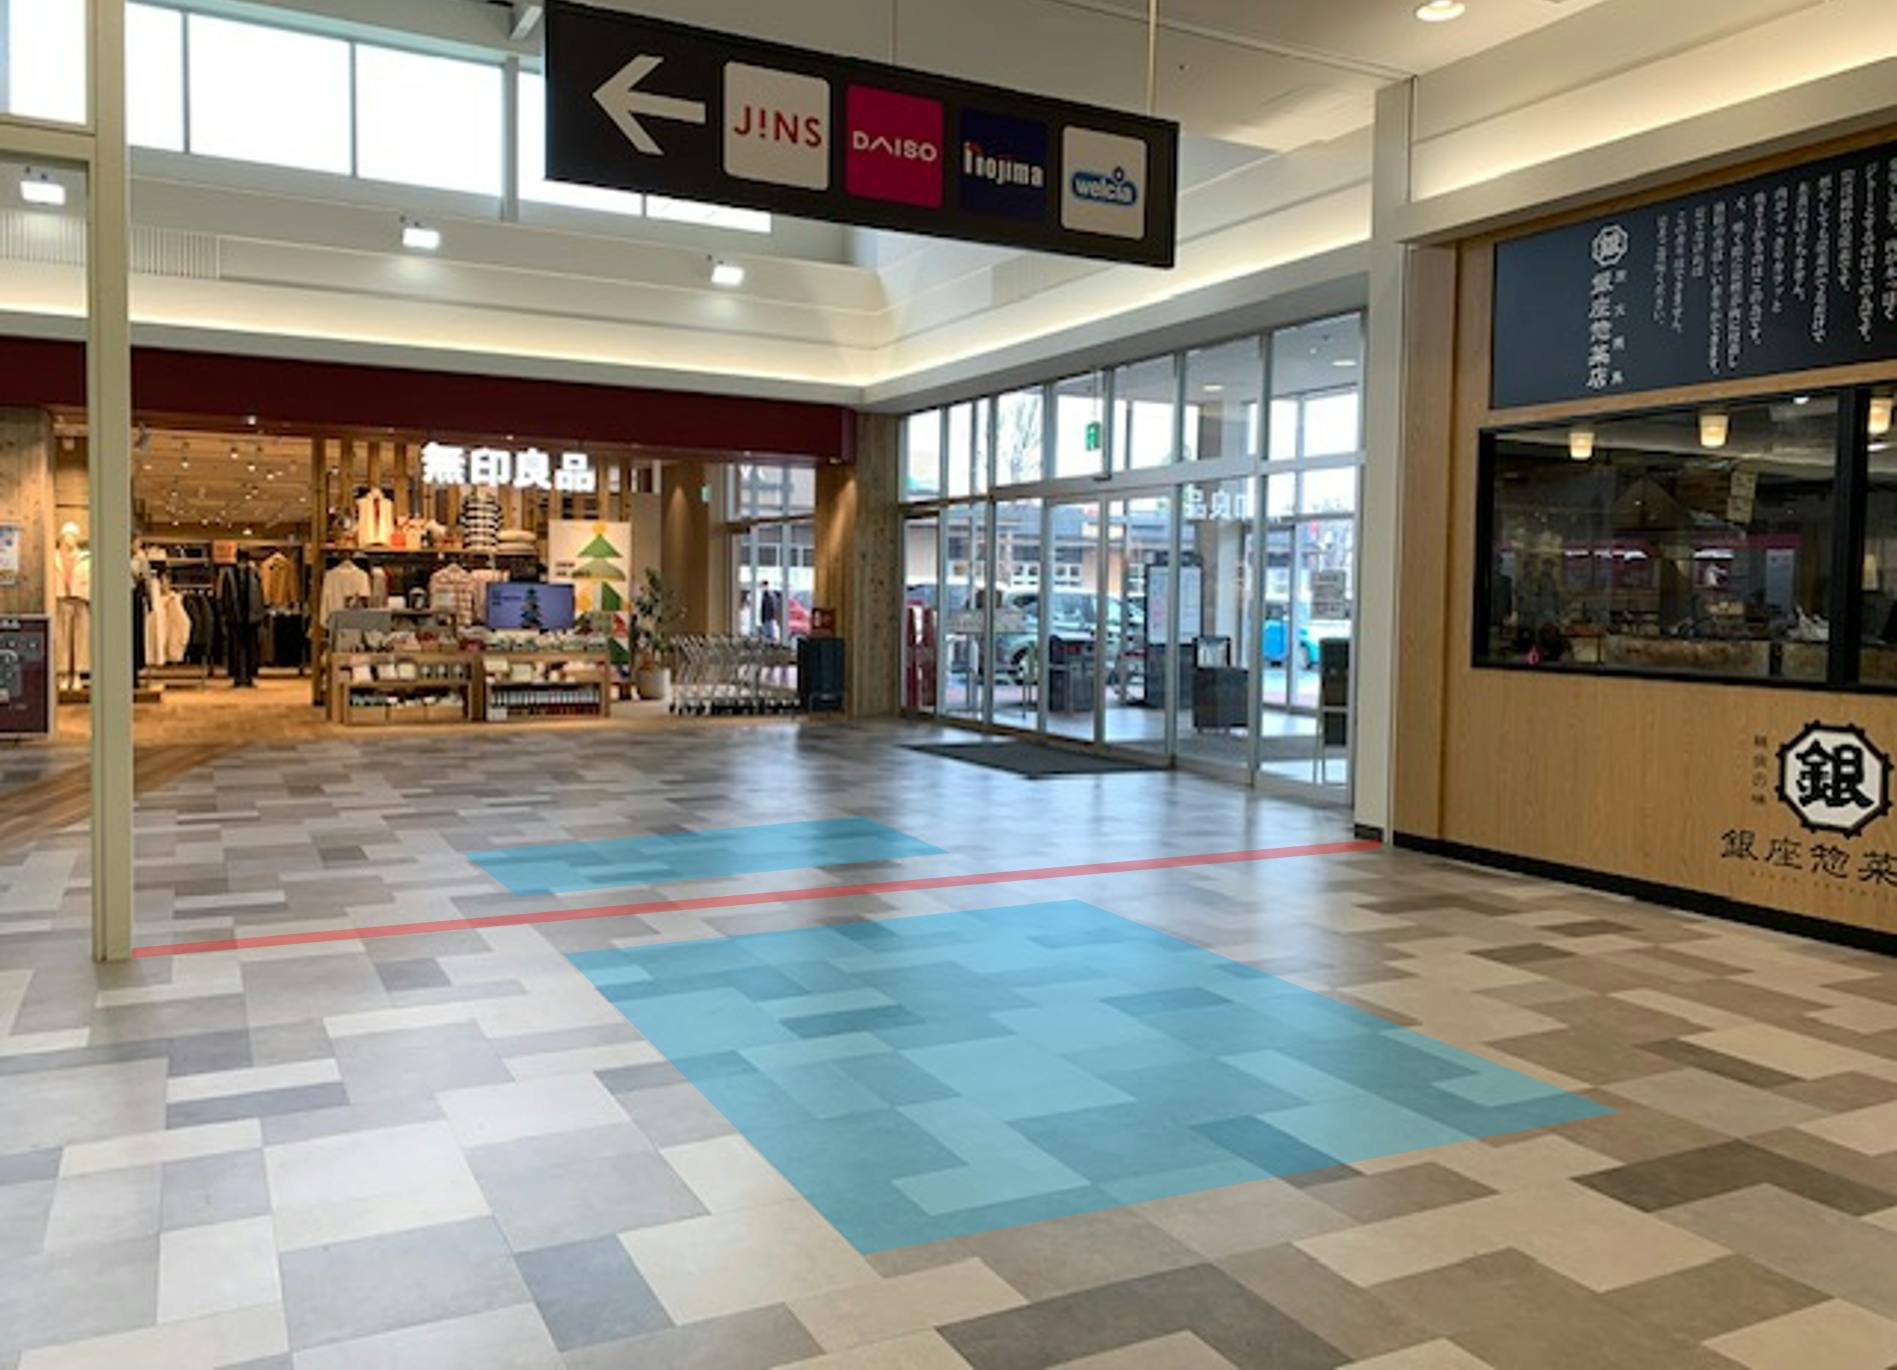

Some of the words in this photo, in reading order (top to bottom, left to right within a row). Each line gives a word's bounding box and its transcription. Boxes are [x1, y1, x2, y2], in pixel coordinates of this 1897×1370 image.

[852, 129, 938, 163] DAISO
[421, 441, 597, 493] 無印良品
[1795, 738, 1874, 809] 銀
[1721, 829, 1897, 886] 銀座惣菜
